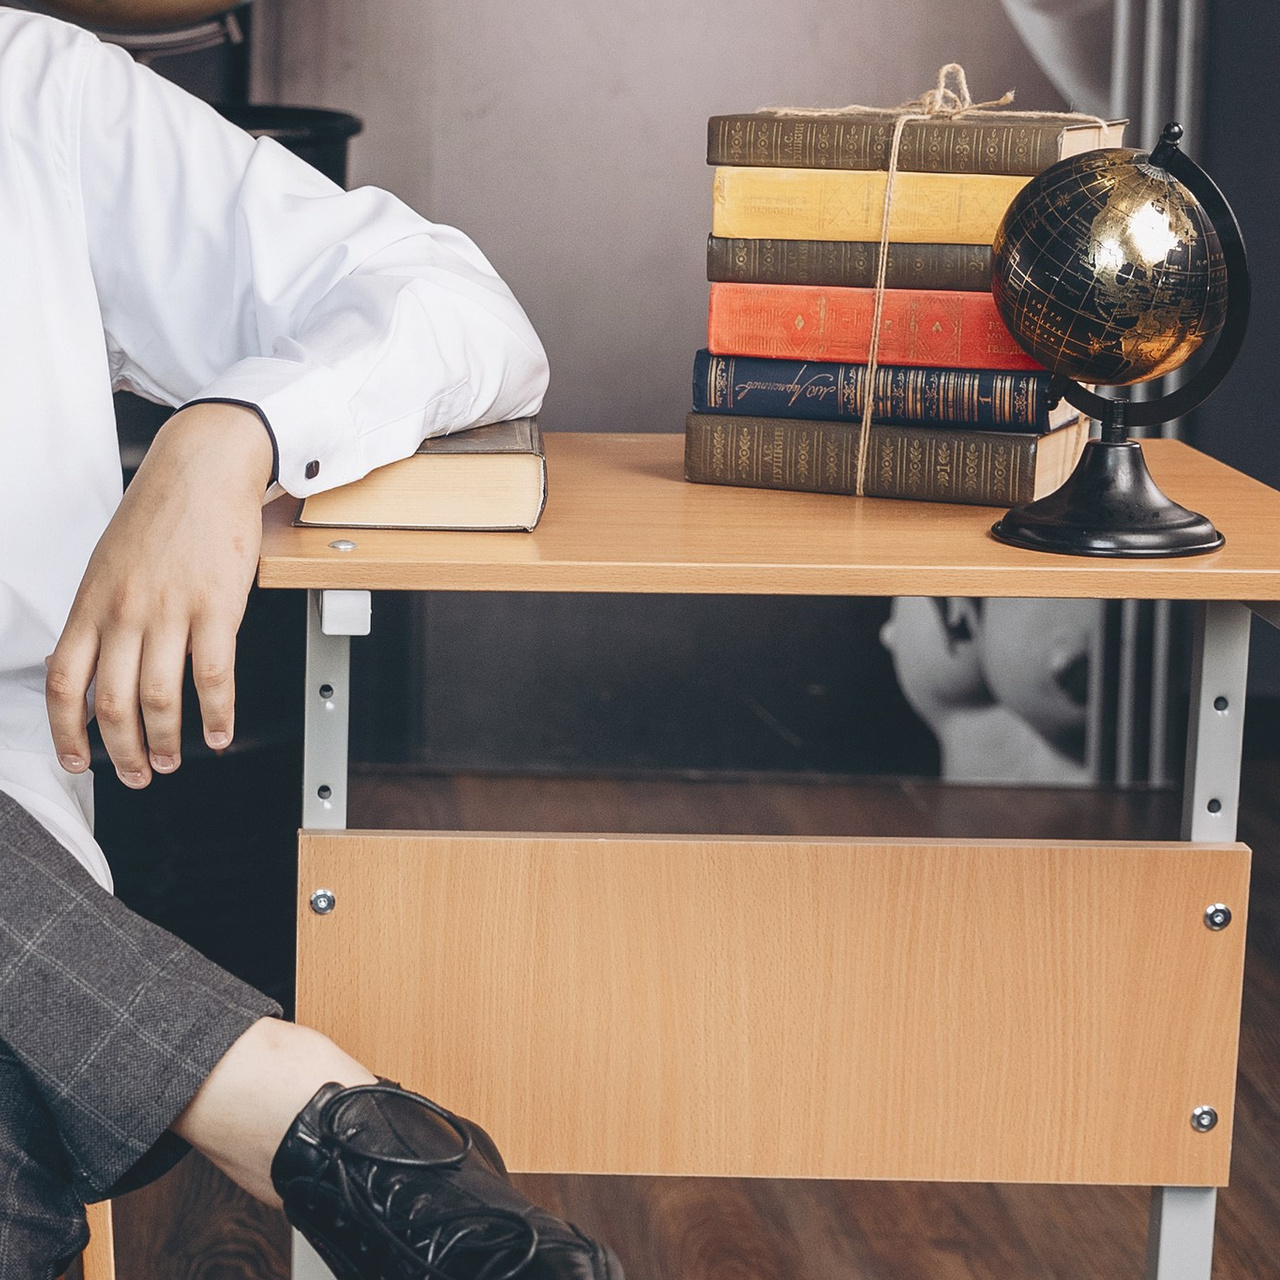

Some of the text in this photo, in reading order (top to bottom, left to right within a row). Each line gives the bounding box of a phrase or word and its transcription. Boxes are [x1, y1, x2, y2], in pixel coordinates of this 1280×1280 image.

[783, 132, 793, 154] А.С.
[793, 123, 805, 167] ПУШКИН
[1031, 299, 1062, 321] SOUTH
[979, 396, 991, 405] 1
[773, 426, 784, 483] ПУШКИН
